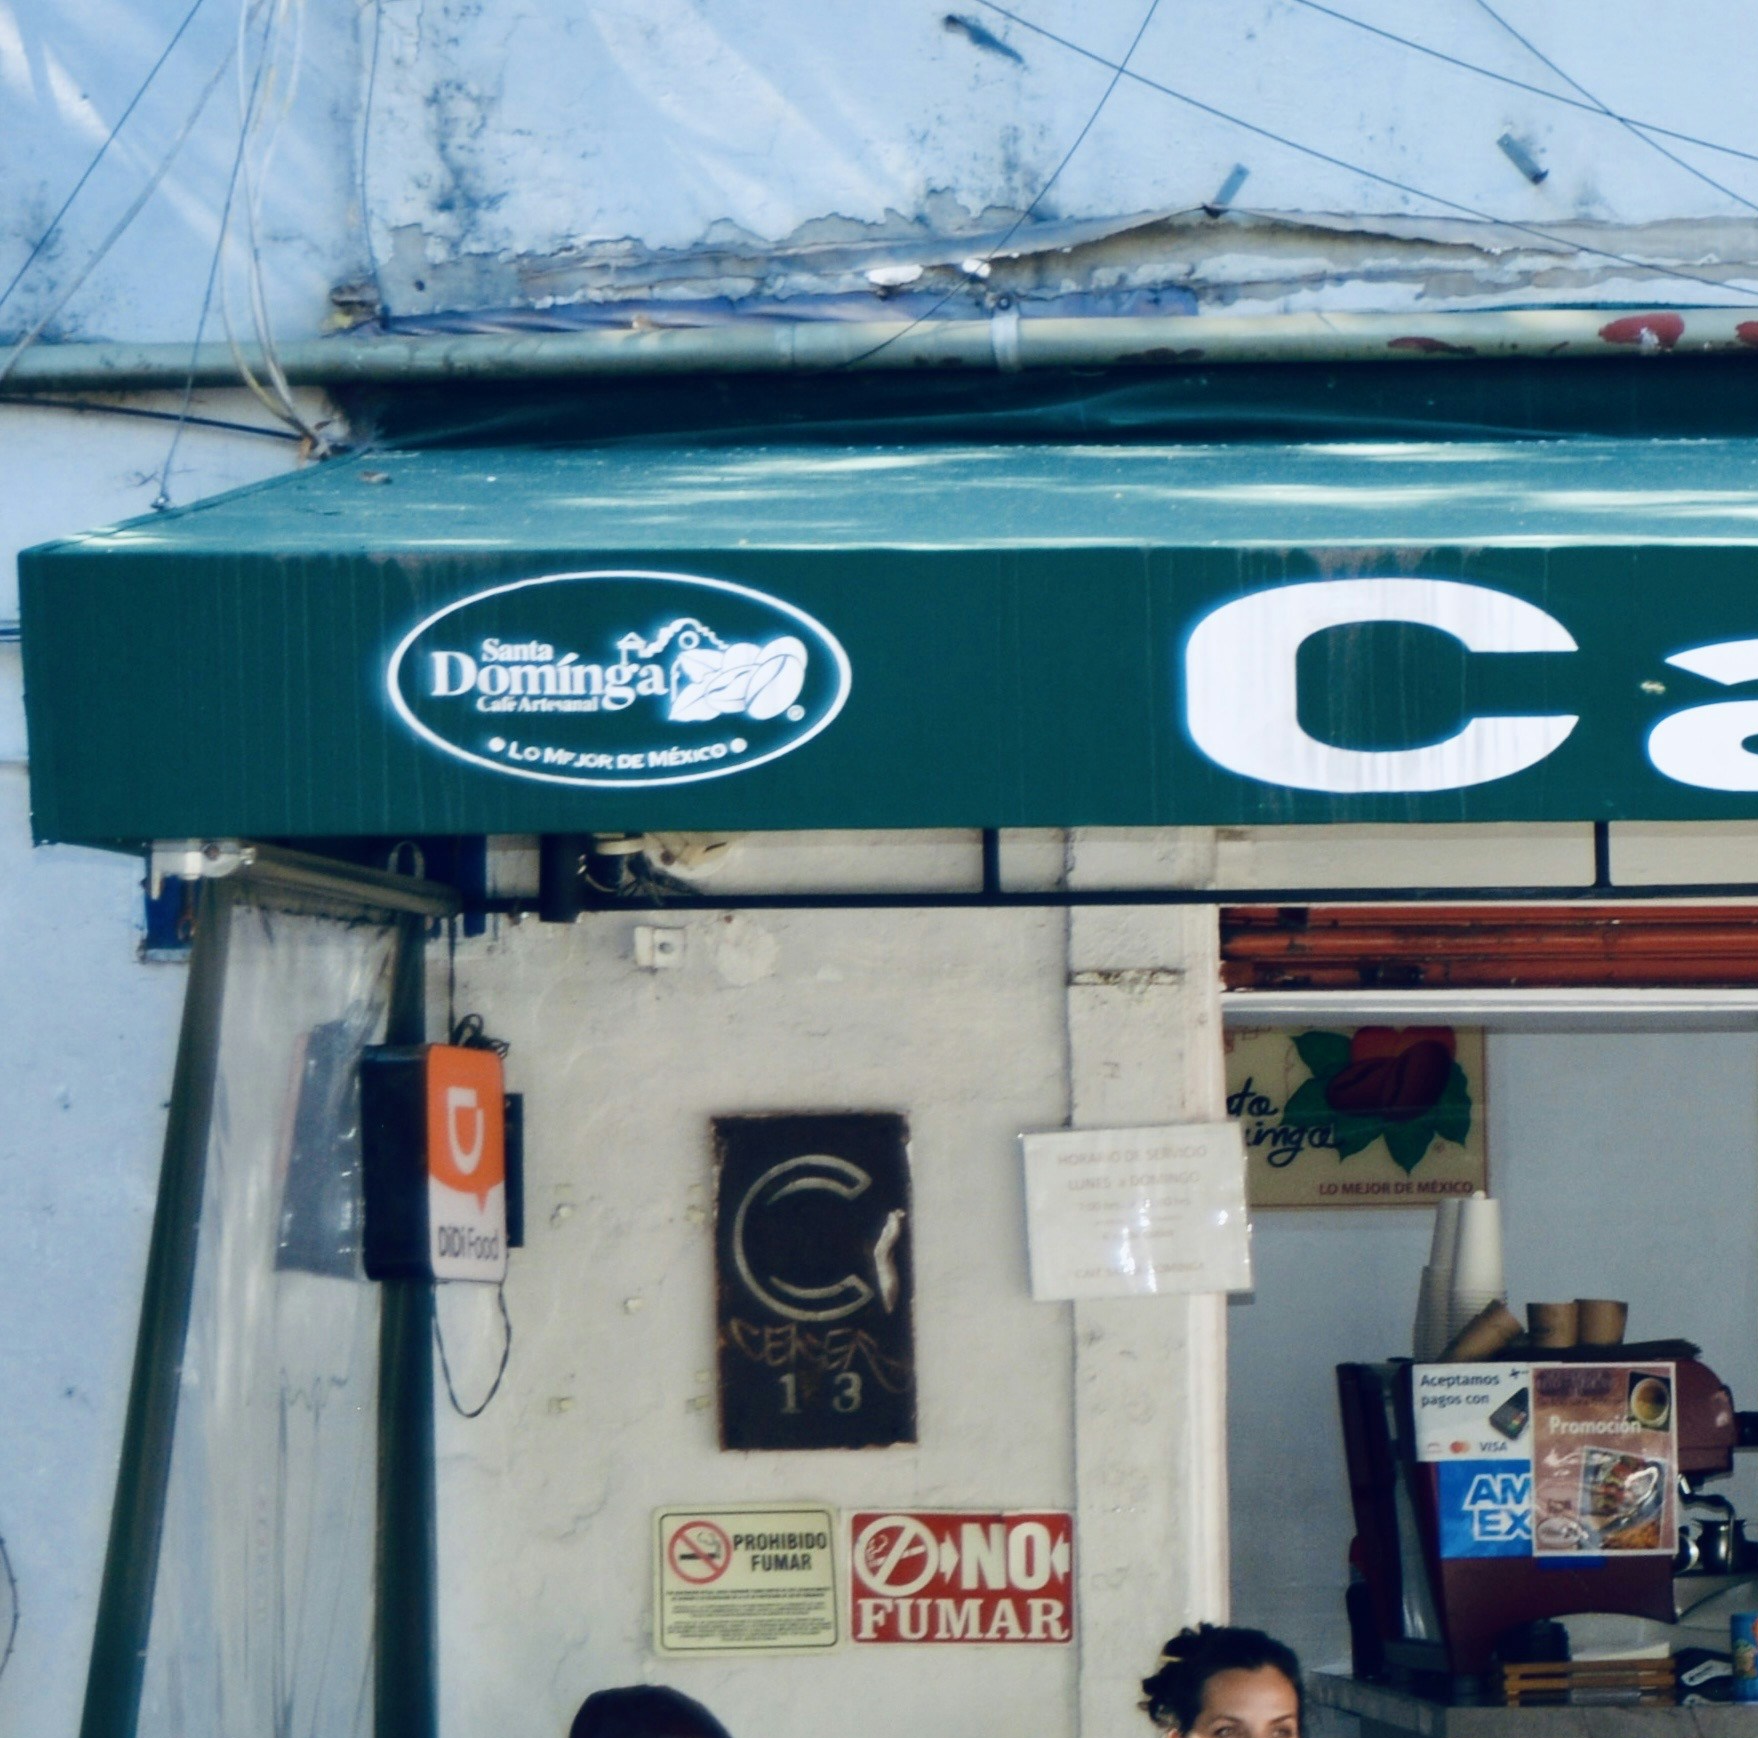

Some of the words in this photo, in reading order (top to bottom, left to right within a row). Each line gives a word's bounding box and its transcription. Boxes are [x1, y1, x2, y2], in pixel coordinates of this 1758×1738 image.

[481, 637, 554, 663] Santa
[1319, 1183, 1336, 1196] LO
[1342, 1182, 1391, 1195] MEJOR
[1394, 1182, 1414, 1195] DE
[438, 1226, 465, 1259] DiDi
[467, 1227, 500, 1262] Food
[1420, 1373, 1501, 1390] Aceptamos
[1421, 1393, 1462, 1408] pagos
[1465, 1393, 1490, 1406] con
[1478, 1441, 1508, 1453] VISA
[733, 1532, 828, 1551] PROHIBIDO
[751, 1553, 812, 1572] FUMAR
[960, 1521, 1051, 1591] NO
[856, 1598, 1070, 1641] FUMAR
